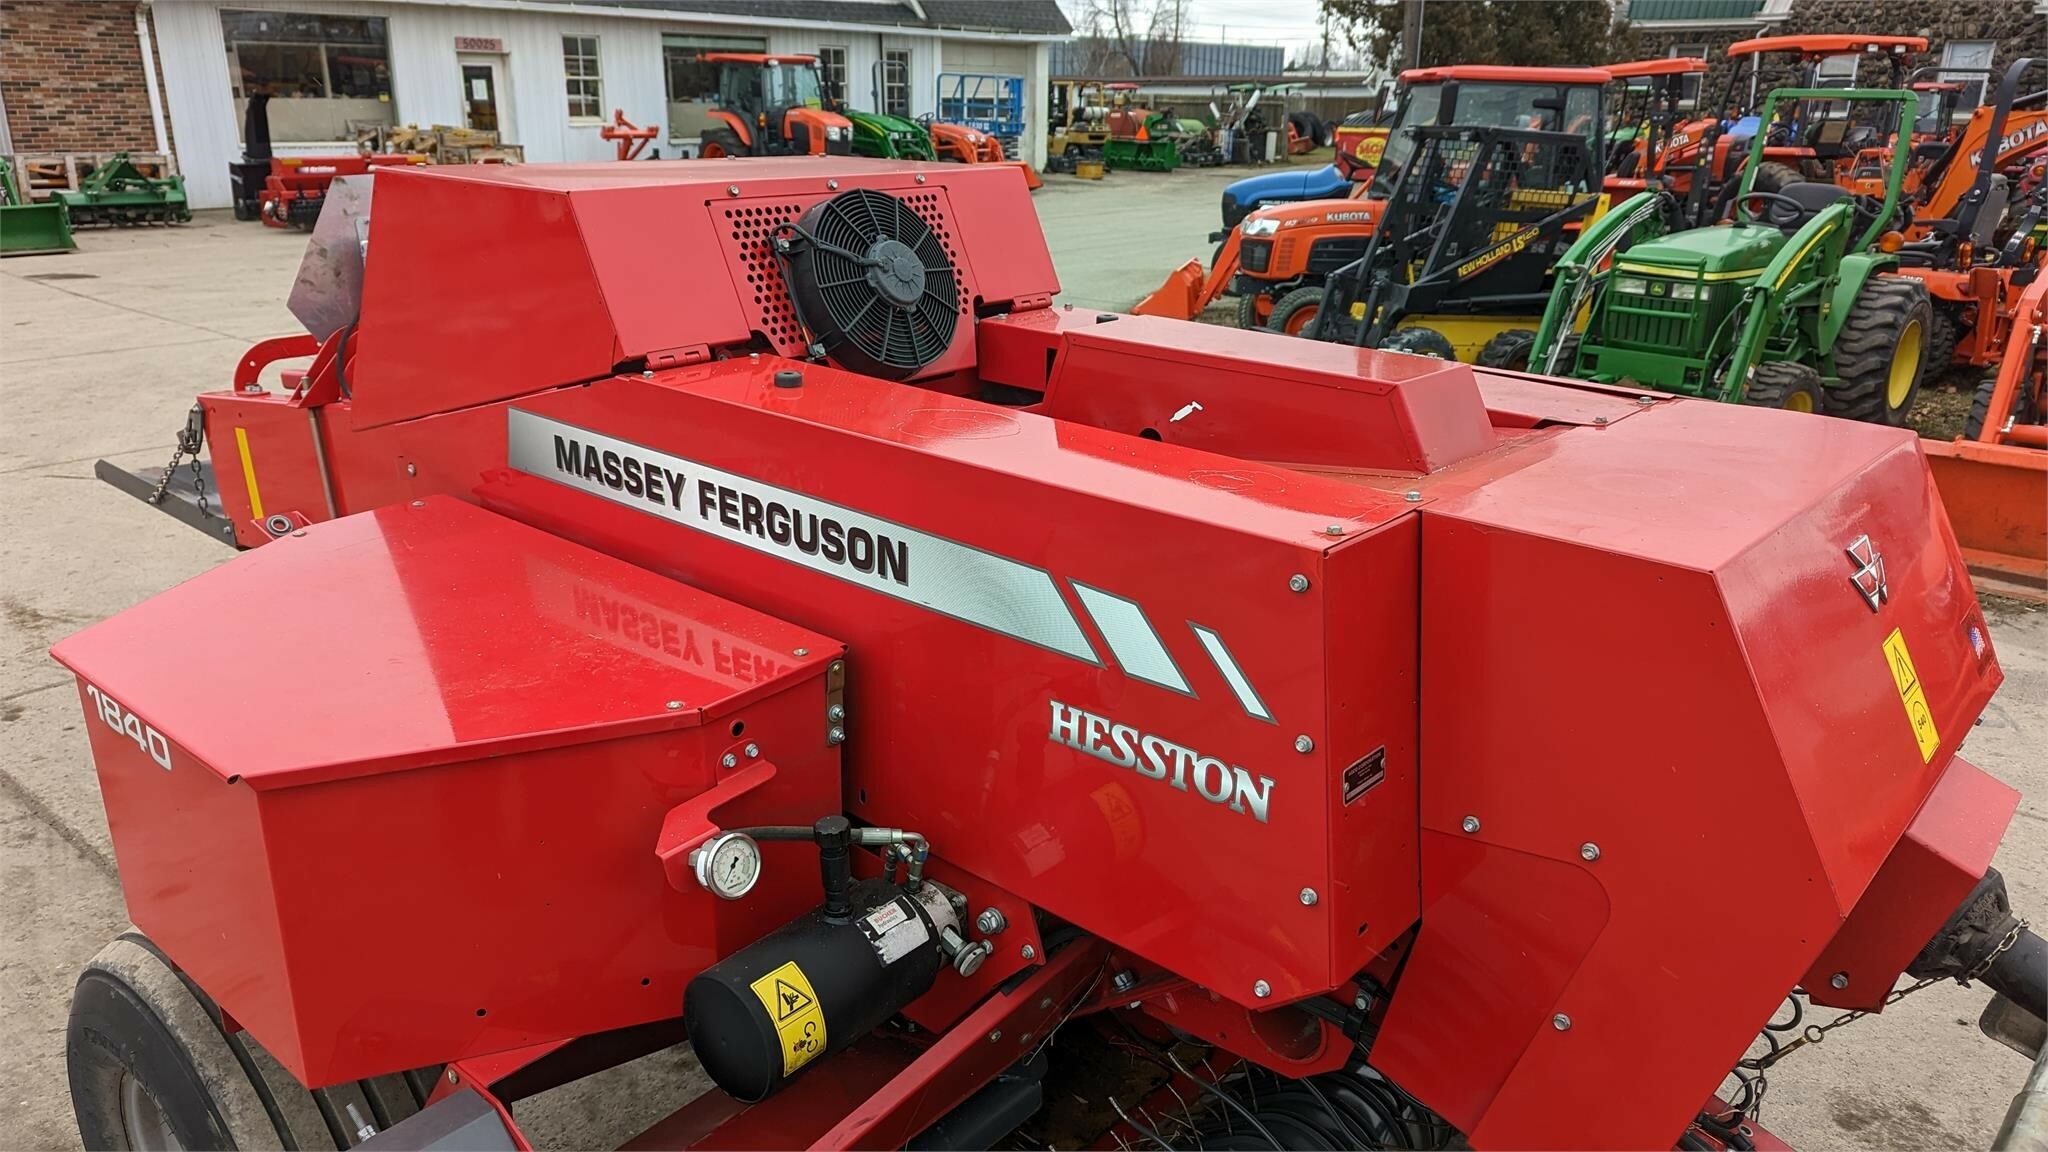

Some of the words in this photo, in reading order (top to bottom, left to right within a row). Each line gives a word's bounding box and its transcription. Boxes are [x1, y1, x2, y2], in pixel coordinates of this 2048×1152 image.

[463, 37, 496, 50] 50025
[1655, 134, 1689, 153] KOTA
[1970, 119, 2048, 168] KBOTA
[1326, 211, 1371, 222] KUBOTA
[1475, 242, 1511, 268] HOLLAND
[554, 433, 687, 511] MASSEY
[698, 478, 910, 587] FERGUSON
[86, 683, 173, 771] 1840
[1048, 700, 1275, 824] HESSTON
